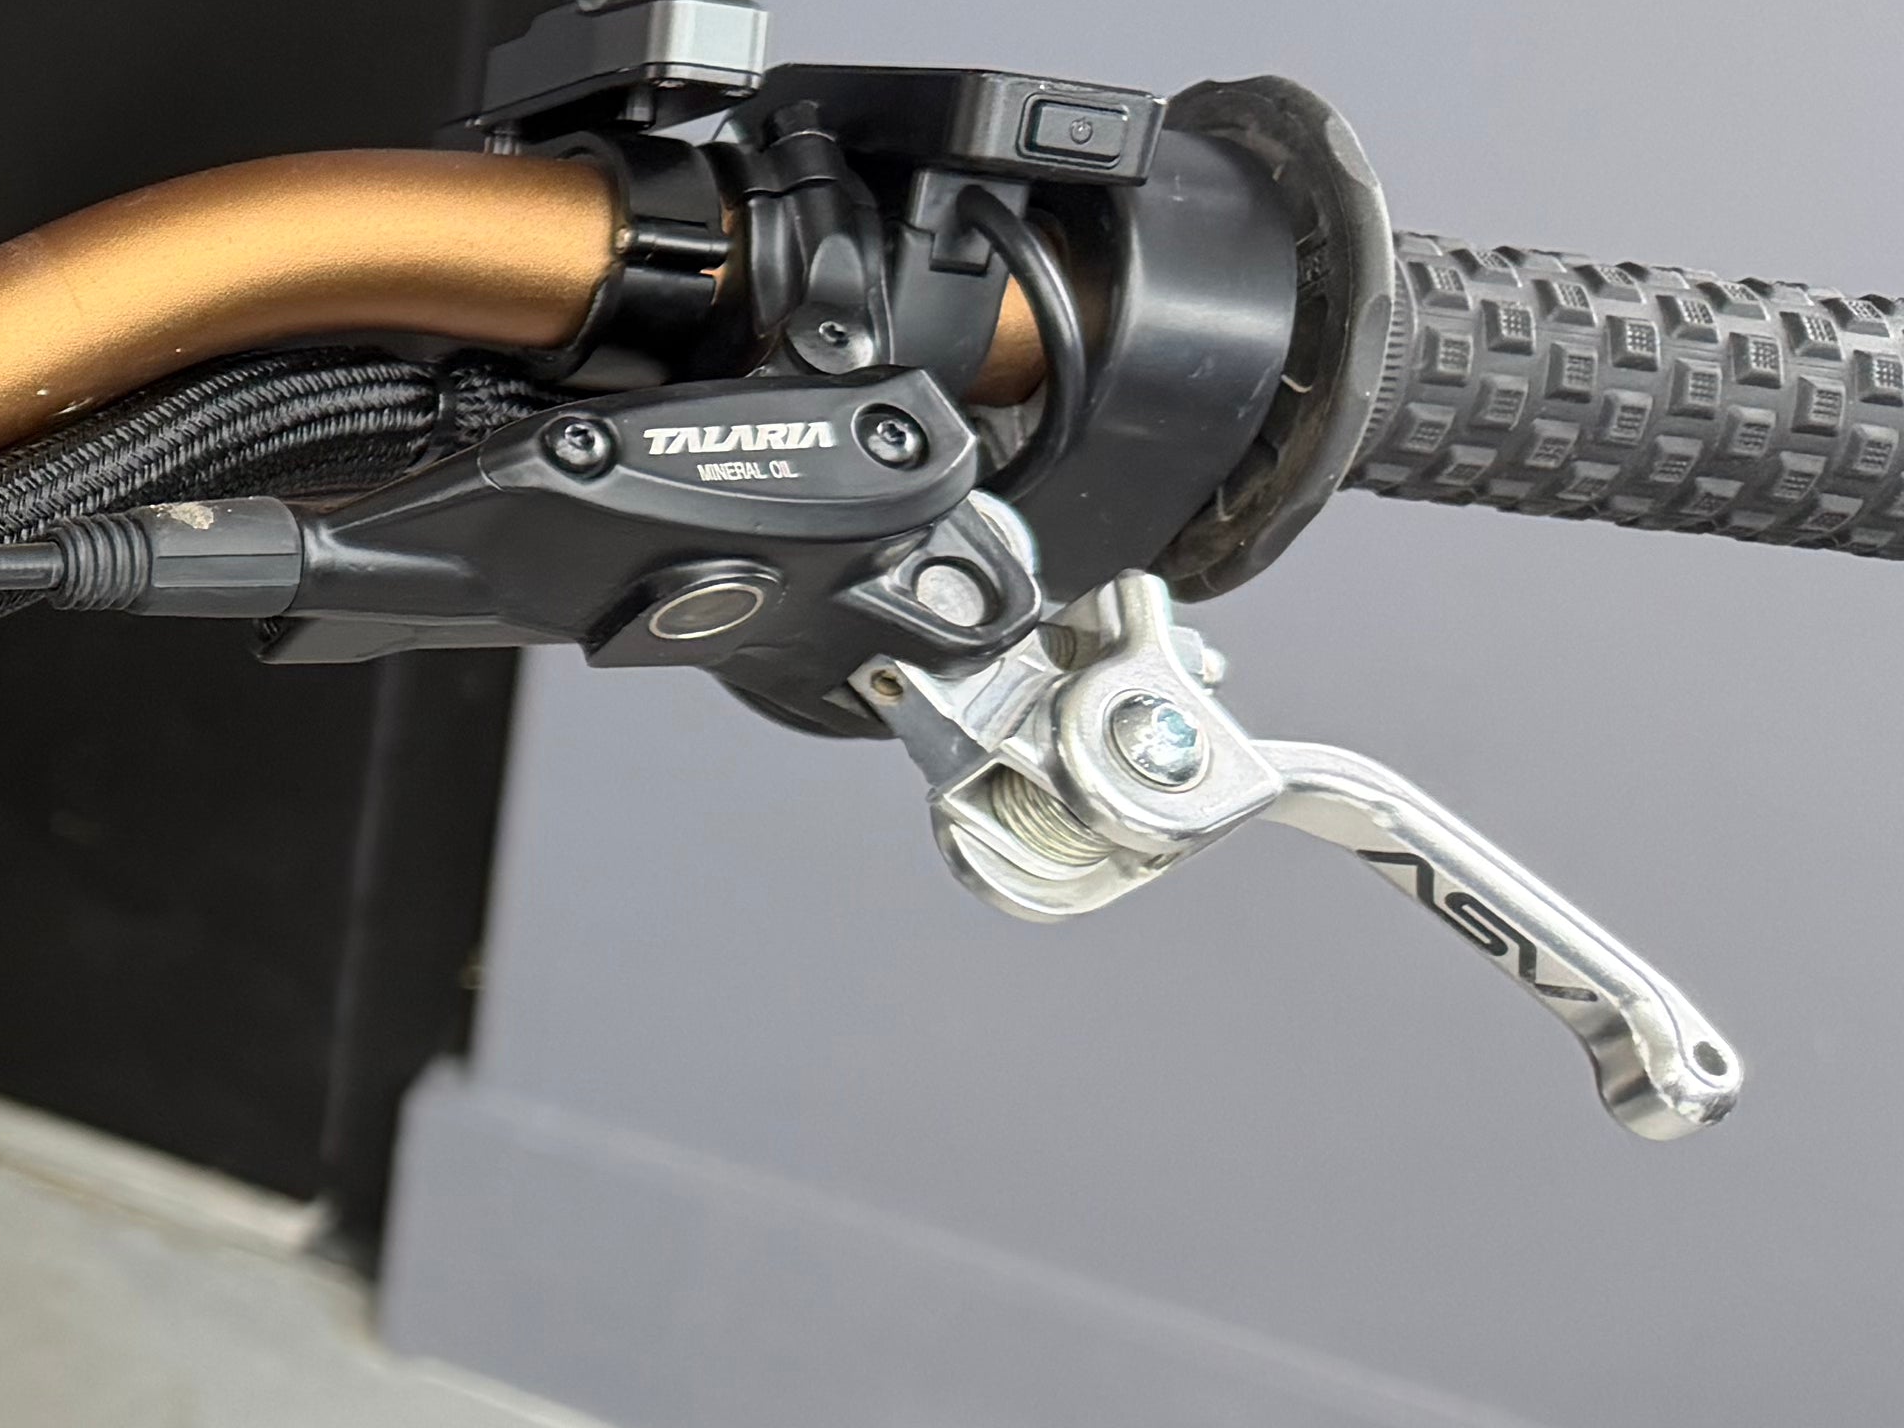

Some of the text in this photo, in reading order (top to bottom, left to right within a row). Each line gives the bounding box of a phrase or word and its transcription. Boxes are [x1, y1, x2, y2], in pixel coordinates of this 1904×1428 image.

[643, 421, 837, 455] TALARIA
[696, 460, 800, 481] MINERAL OIL
